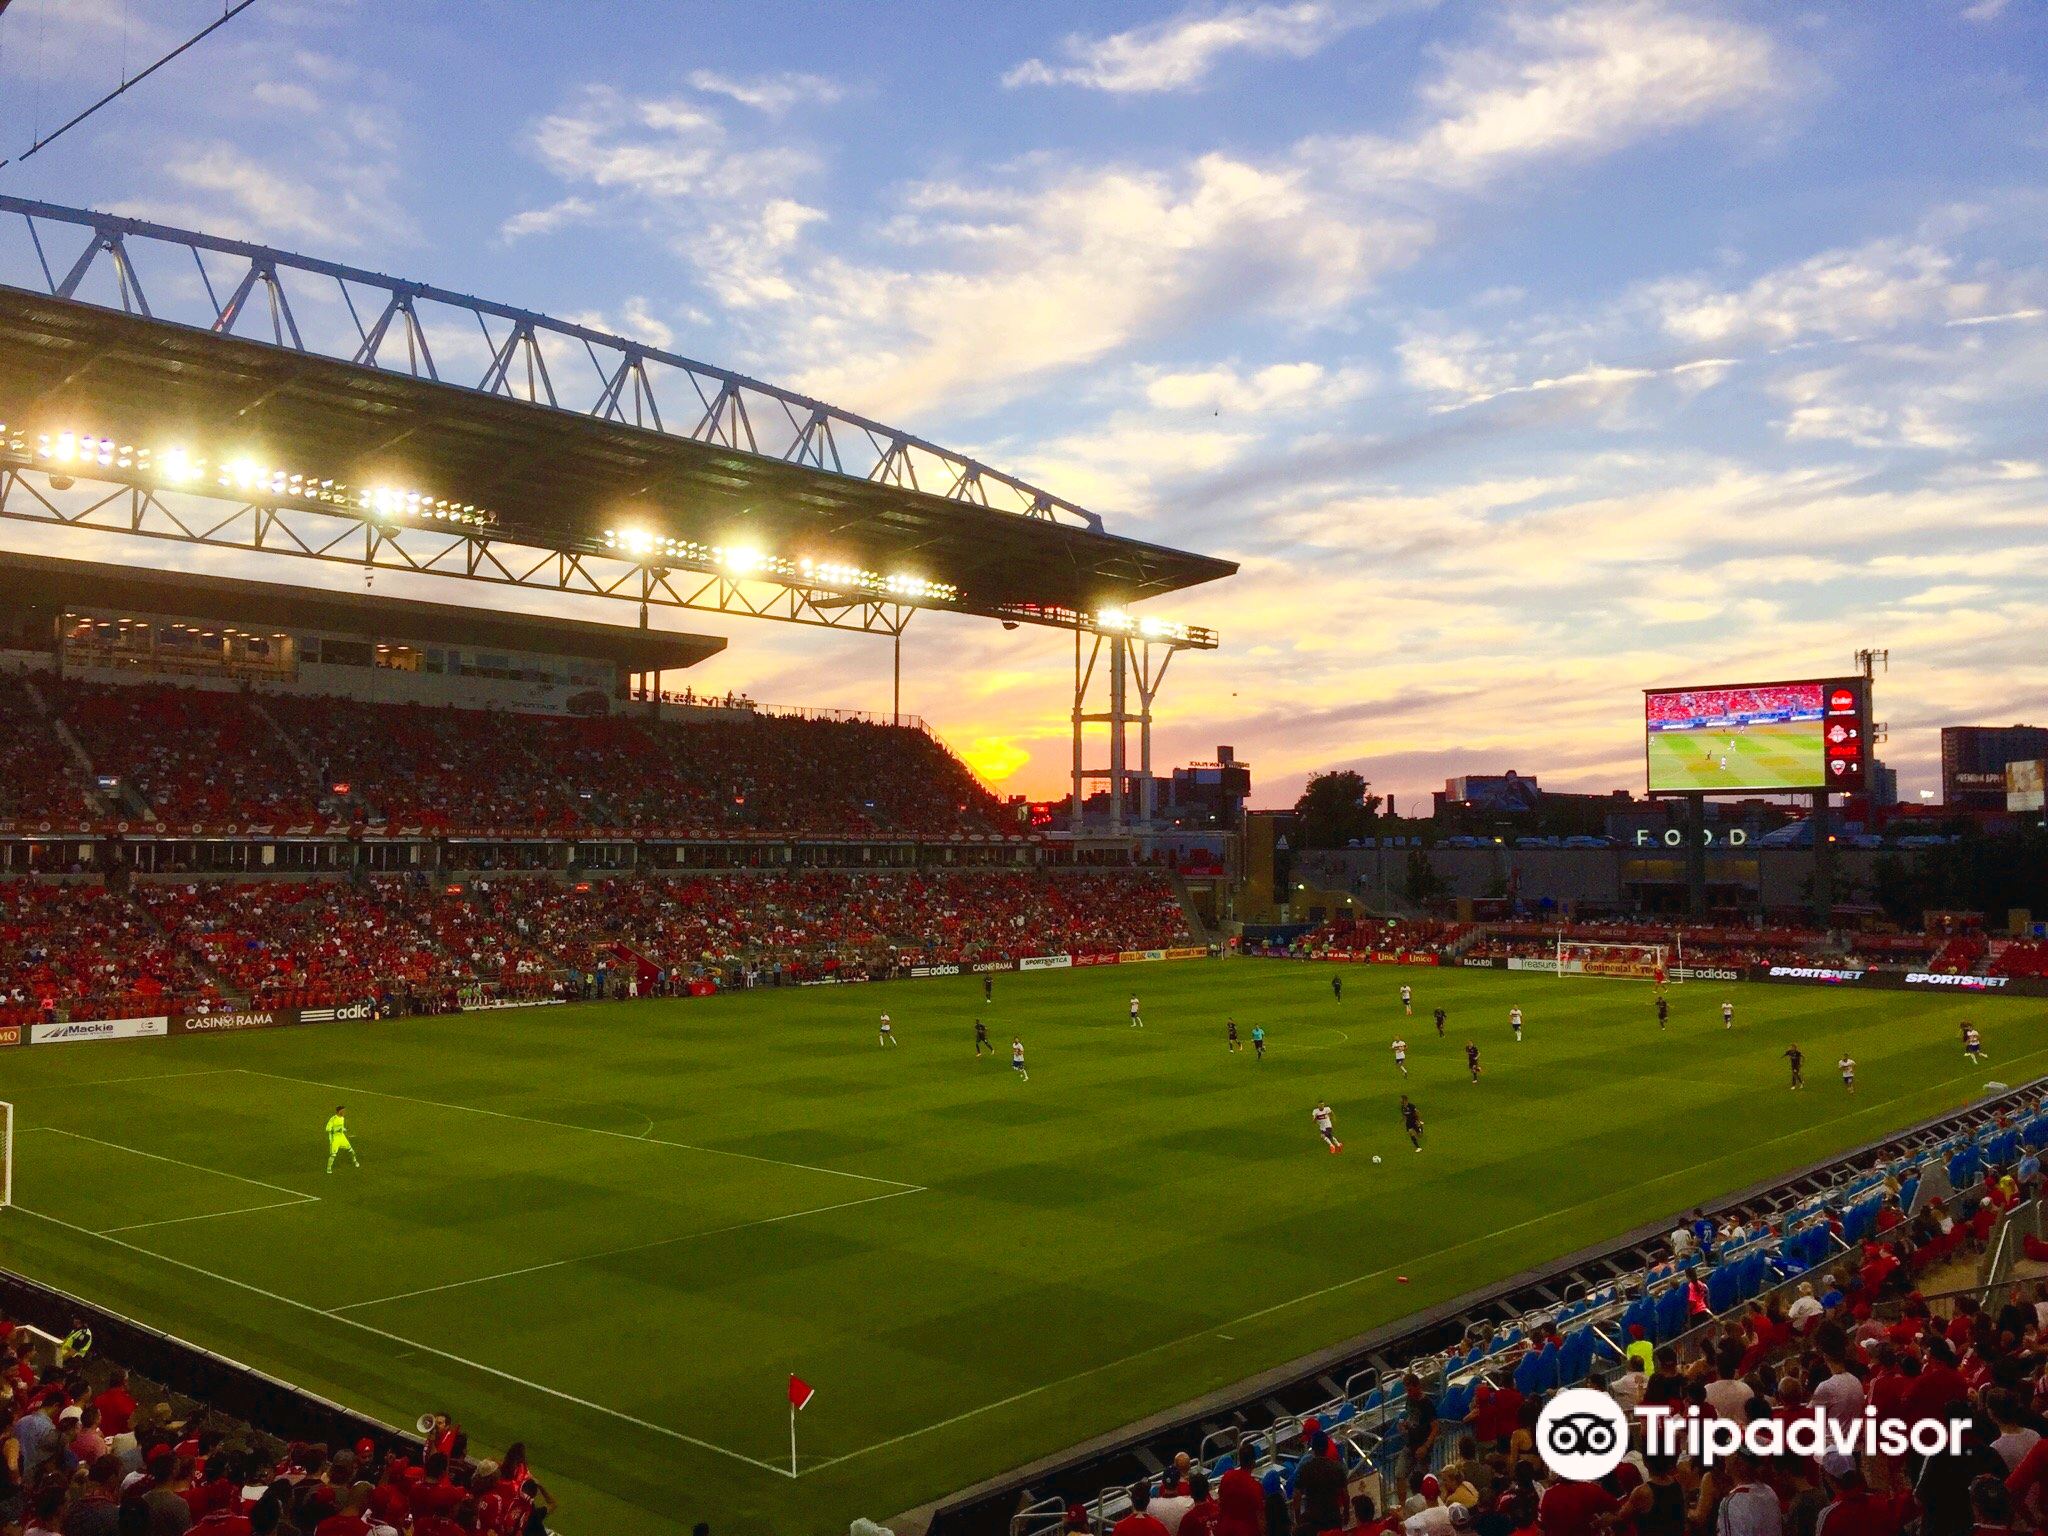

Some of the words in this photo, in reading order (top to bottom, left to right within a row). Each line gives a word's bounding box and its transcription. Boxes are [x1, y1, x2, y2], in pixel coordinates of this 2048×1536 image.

[1849, 729, 1857, 738] 3
[1850, 763, 1857, 772] 1
[1409, 954, 1432, 963] Unico
[930, 965, 959, 976] adidas
[1696, 968, 1737, 980] adidas
[1769, 966, 1864, 980] SPORTSNET
[1905, 972, 2010, 987] SPORTSNET
[337, 1004, 390, 1019] adids
[236, 1013, 273, 1026] RAMA
[68, 1023, 114, 1034] Mackie
